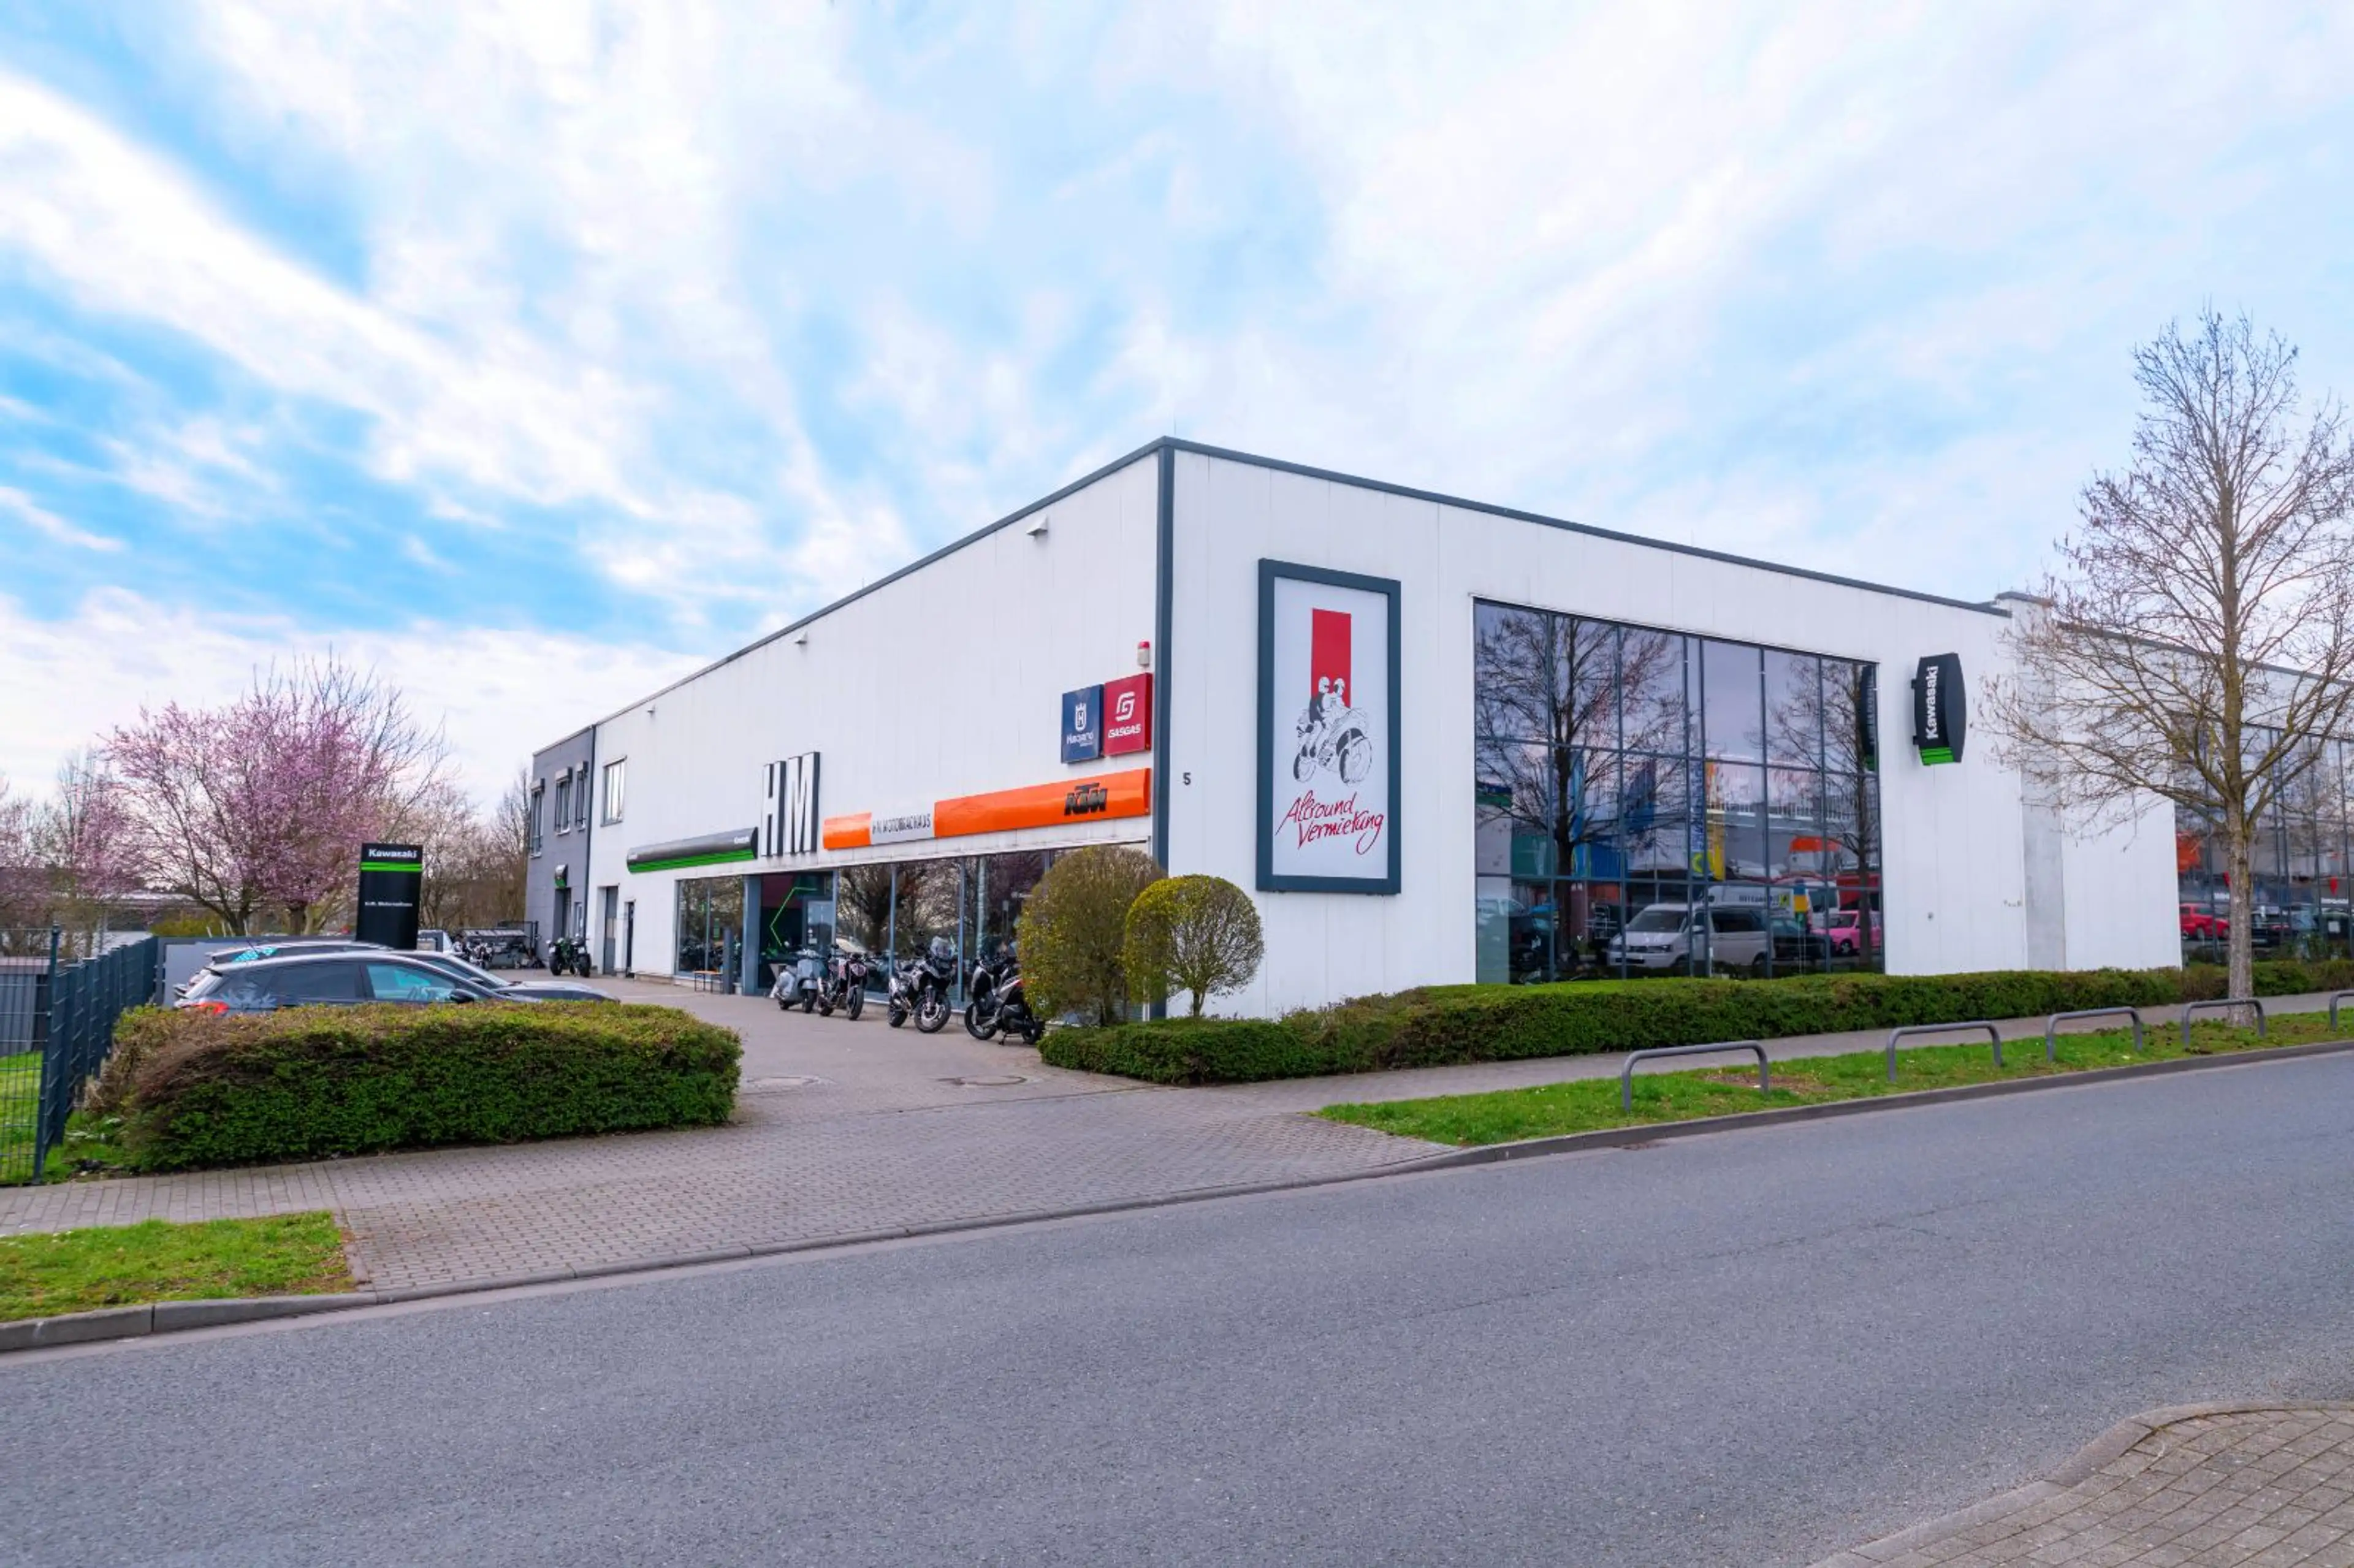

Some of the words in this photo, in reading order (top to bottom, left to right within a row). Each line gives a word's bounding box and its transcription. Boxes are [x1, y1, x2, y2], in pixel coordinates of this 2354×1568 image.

[1925, 666, 1939, 740] Kawasaki
[1108, 723, 1141, 738] GASGAS
[1183, 772, 1192, 785] 5
[761, 752, 820, 857] HM
[1064, 783, 1108, 816] KTM
[1274, 790, 1357, 836] Allround
[1298, 810, 1384, 855] Vermietung
[368, 849, 417, 858] Kawasaki
